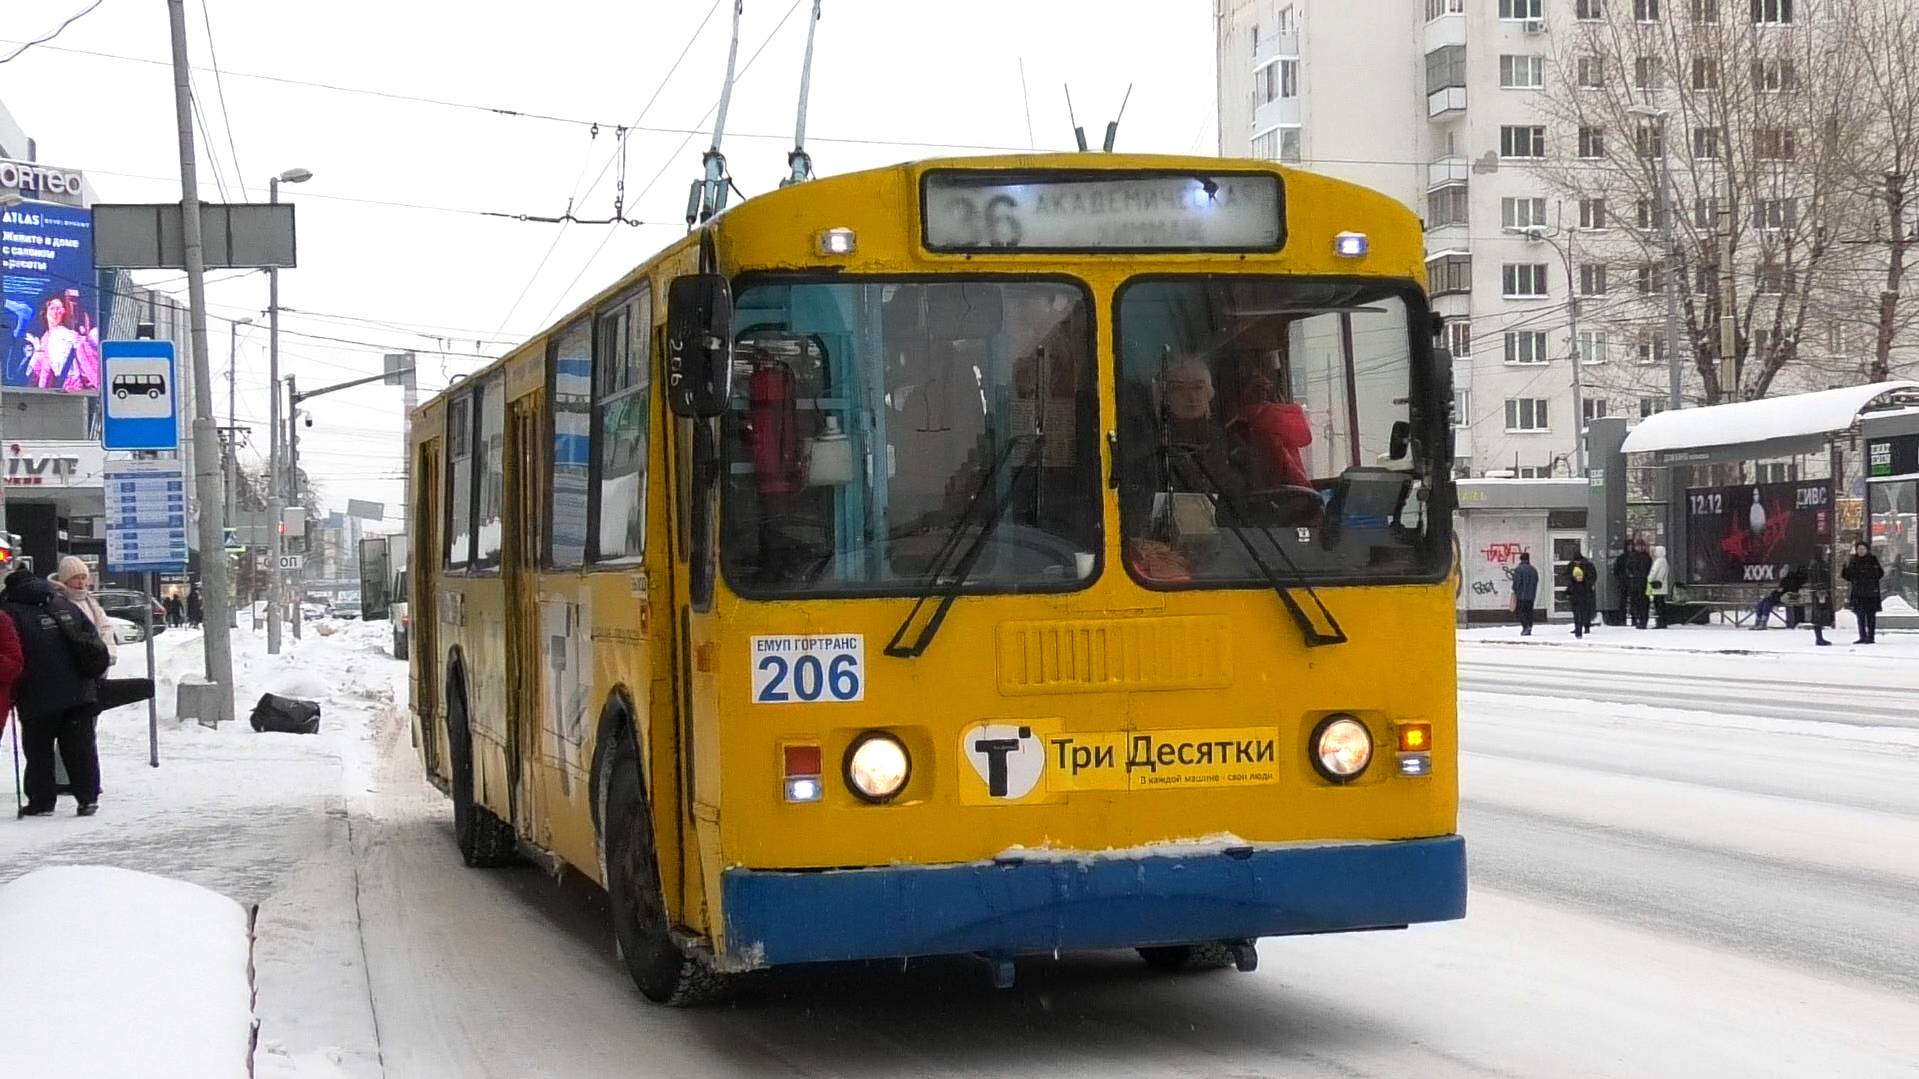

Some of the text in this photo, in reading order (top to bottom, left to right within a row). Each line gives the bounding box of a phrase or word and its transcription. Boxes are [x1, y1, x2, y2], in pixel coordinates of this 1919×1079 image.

[2, 211, 40, 225] ATLAS
[670, 338, 683, 387] 206
[757, 637, 857, 652] ЕМУП ГОРТРАНС
[758, 653, 859, 702] 206
[1051, 735, 1275, 776] Три Десятки
[1148, 775, 1181, 785] каждой
[1184, 774, 1220, 783] машине
